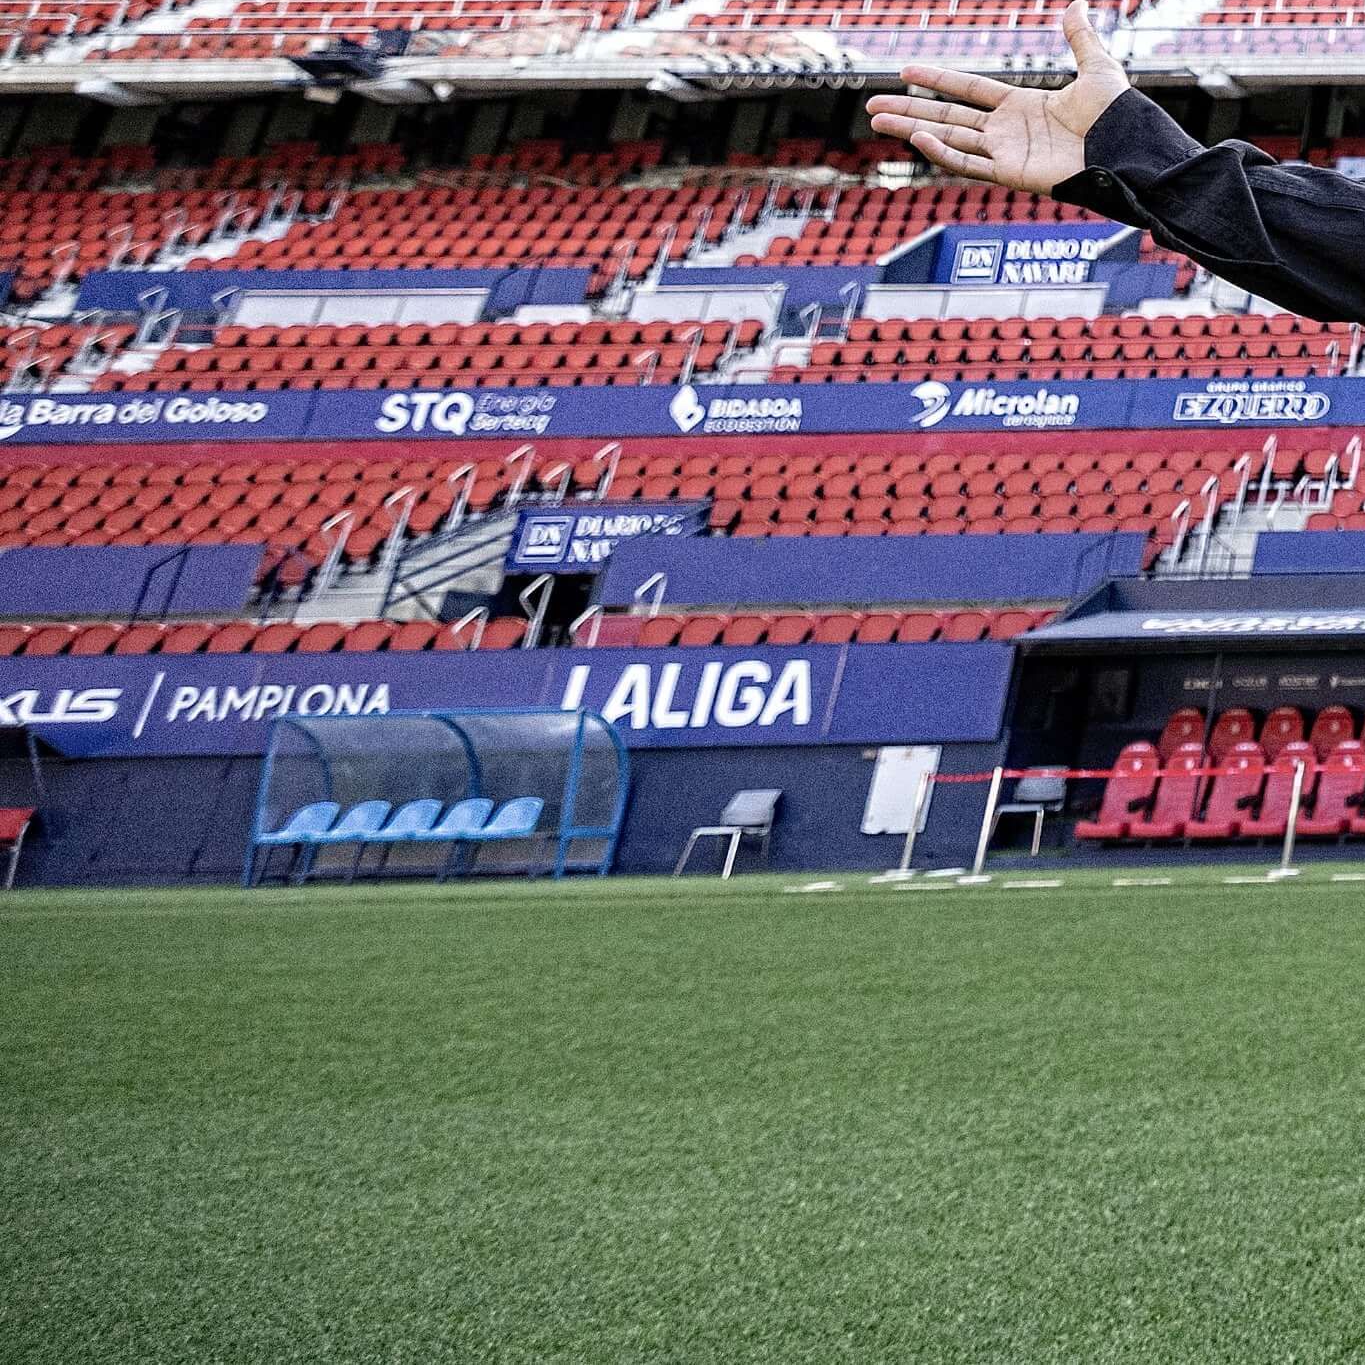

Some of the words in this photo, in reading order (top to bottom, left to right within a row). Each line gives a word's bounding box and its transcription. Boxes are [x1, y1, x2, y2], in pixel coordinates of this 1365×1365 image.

[1006, 240, 1078, 259] DIARIO
[1002, 261, 1090, 283] NAVARR
[27, 399, 117, 425] Barra
[117, 398, 165, 424] del
[165, 397, 268, 423] Goloso
[375, 392, 475, 435] STQ
[951, 389, 1080, 416] Microlan
[166, 683, 391, 723] PAMPLONA
